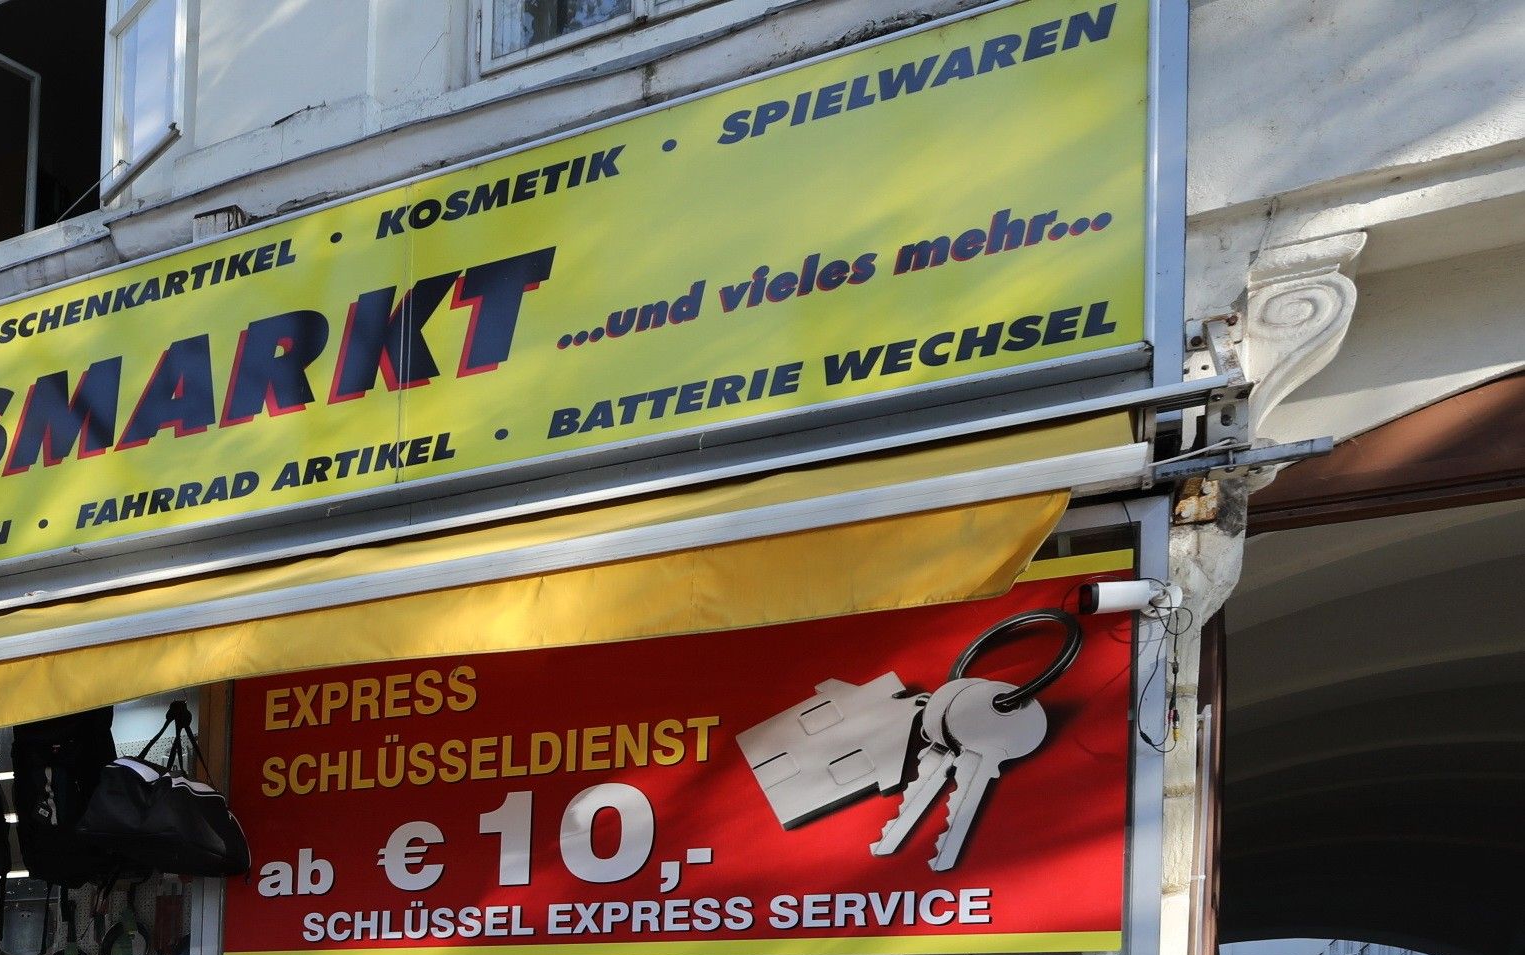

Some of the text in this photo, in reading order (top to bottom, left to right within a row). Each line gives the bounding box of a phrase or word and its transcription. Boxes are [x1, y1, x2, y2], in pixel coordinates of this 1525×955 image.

[376, 144, 626, 238] KOSMETIK
[718, 3, 1117, 145] SPIELWAREN
[719, 251, 878, 314] vieles
[893, 208, 1113, 277] mehr...
[75, 469, 259, 530] FAHRRAD
[270, 431, 456, 492] ARTIKEL
[547, 360, 804, 440] BATTERIE
[823, 300, 1117, 387] WECHSEL
[264, 665, 478, 732] EXPRESS
[261, 714, 721, 798] SCHLÜSSELDIENST
[257, 848, 336, 899] ab
[377, 819, 445, 891] €
[302, 887, 993, 943] SCHLÜSSEL EXPRESS SERVICE
